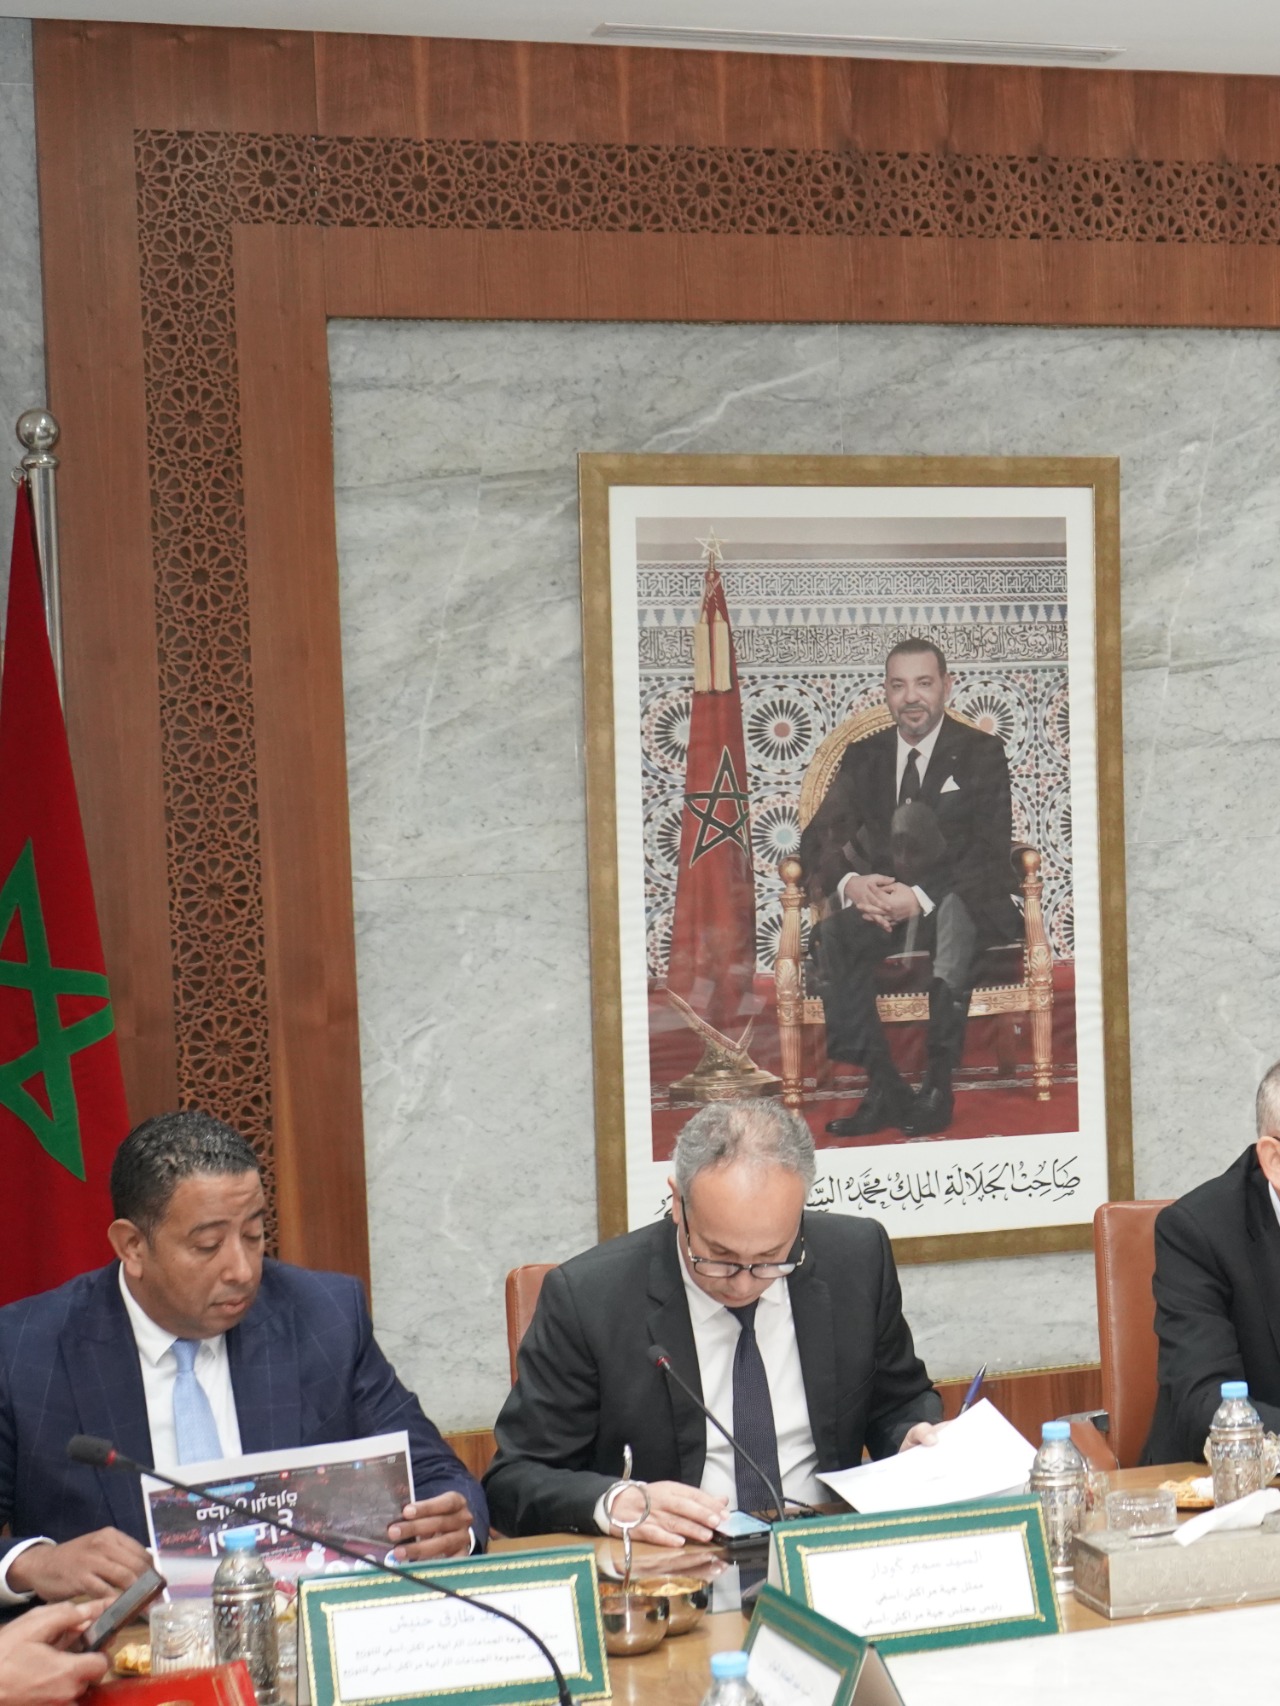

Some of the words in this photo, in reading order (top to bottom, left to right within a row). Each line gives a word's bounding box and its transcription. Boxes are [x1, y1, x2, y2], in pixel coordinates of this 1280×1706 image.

[945, 1549, 983, 1568] السيد
[910, 1561, 942, 1575] سمير
[939, 1584, 957, 1595] جهة
[961, 1581, 984, 1594] ممثل
[926, 1608, 944, 1620] جهة
[947, 1603, 976, 1618] مجلس
[978, 1601, 1003, 1614] رئيس
